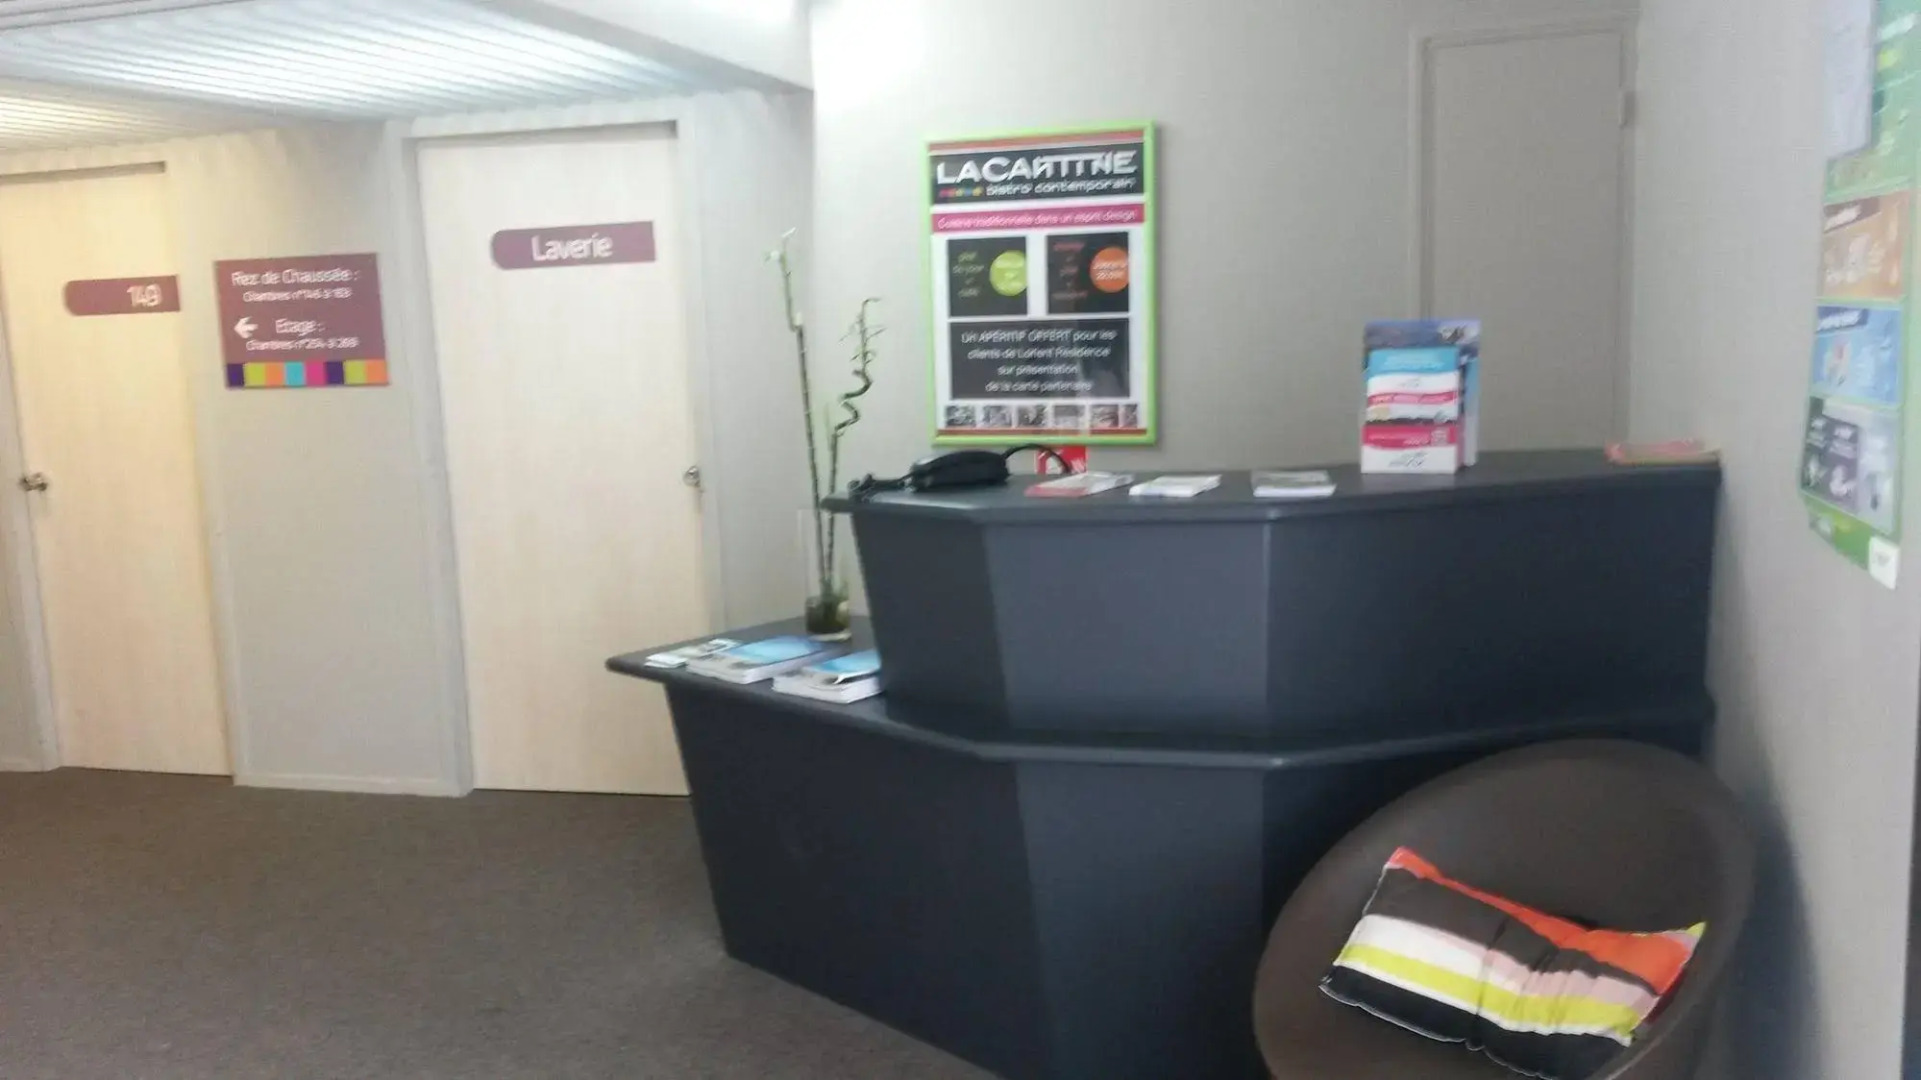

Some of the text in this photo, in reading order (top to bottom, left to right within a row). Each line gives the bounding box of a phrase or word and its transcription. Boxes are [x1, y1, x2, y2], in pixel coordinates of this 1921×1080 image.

[531, 232, 613, 262] Laverie
[260, 270, 281, 285] de
[126, 283, 162, 307] 149
